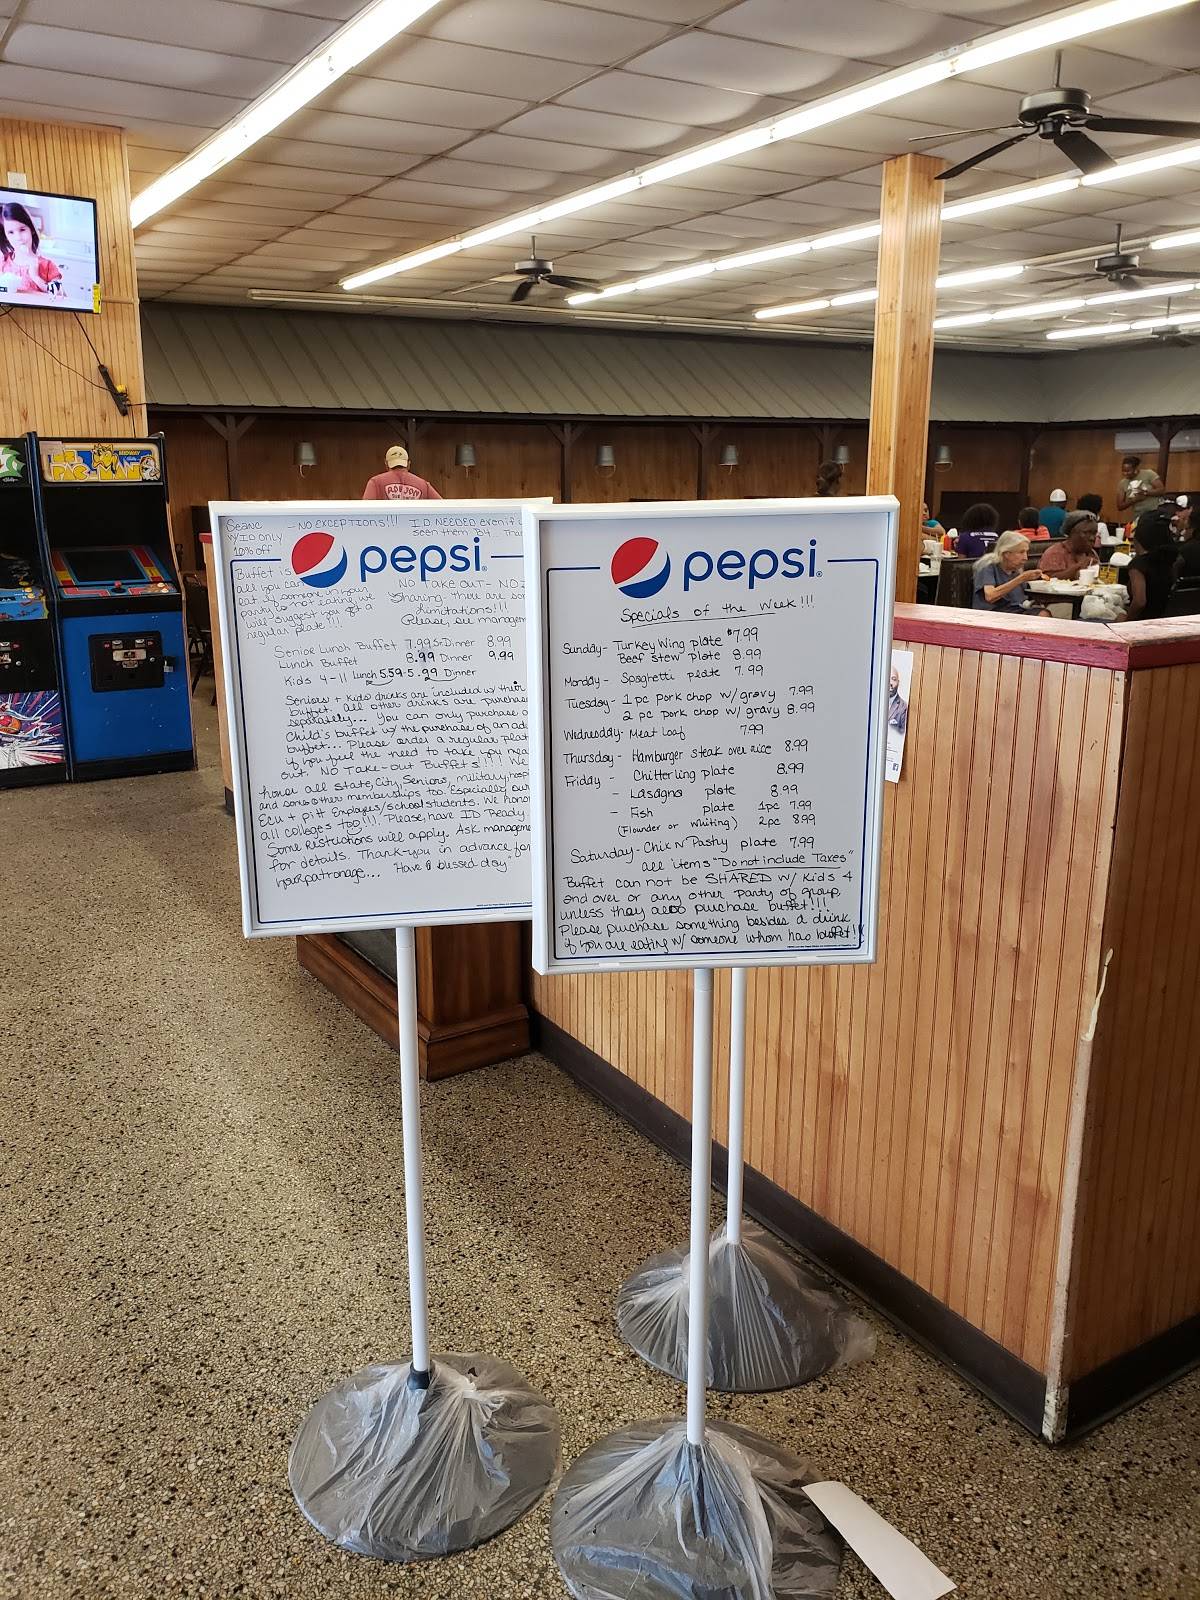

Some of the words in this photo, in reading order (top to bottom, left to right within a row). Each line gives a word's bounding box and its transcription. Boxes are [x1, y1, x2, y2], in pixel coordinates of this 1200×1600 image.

[360, 536, 480, 582] pepsi
[683, 539, 816, 592] pepsi
[235, 566, 274, 581] Buffet
[620, 606, 680, 624] Specials
[694, 604, 710, 617] of
[722, 603, 747, 614] the
[319, 643, 351, 654] Lunch
[354, 638, 398, 651] Buffet
[404, 638, 432, 649] 7.99
[487, 635, 512, 647] 8.99
[612, 640, 655, 655] Turkey
[657, 638, 686, 655] Wing
[690, 636, 723, 651] plate
[279, 659, 314, 669] Lunch
[319, 656, 359, 668] Buffet
[440, 653, 473, 663] Dinner
[488, 650, 515, 661] 9.99
[617, 652, 645, 664] Beef
[651, 654, 681, 662] stew
[688, 651, 721, 663] plate
[732, 648, 762, 660] 8.99
[284, 675, 312, 687] Kids
[352, 670, 378, 680] Lunch
[443, 668, 477, 677] Dinner
[620, 670, 675, 688] Spaghetti
[686, 668, 721, 682] plate
[734, 664, 764, 676] 7.99
[686, 692, 713, 703] chop
[788, 685, 814, 696] 7.99
[693, 708, 719, 718] chop
[745, 705, 780, 719] gravy
[786, 701, 816, 714] 8.99
[286, 729, 331, 742] Child's
[335, 727, 378, 738] buffet
[400, 724, 421, 733] the
[421, 723, 475, 734] purchase
[476, 723, 492, 735] of
[629, 728, 658, 739] Meat
[739, 724, 764, 735] 7.99
[632, 748, 684, 766] Hamburger
[690, 745, 723, 759] steak
[728, 746, 747, 756] over
[749, 744, 772, 755] rice
[784, 739, 809, 752] 8.99
[701, 764, 735, 780] plate
[776, 762, 804, 775] 8.99
[630, 788, 683, 804] Lasagna
[704, 783, 736, 800] plate
[770, 783, 799, 798] 8.99
[630, 806, 654, 819] Fish
[702, 801, 736, 815] plate
[789, 800, 812, 811] 7.99
[617, 822, 662, 838] (Flounder
[667, 822, 679, 830] or
[792, 813, 816, 826] 8.99
[267, 841, 302, 858] Some
[378, 830, 405, 843] will
[455, 823, 481, 836] Ask
[740, 837, 778, 851] plate
[789, 836, 815, 849] 7.99
[269, 858, 297, 872] for
[439, 845, 452, 854] in
[459, 842, 512, 853] advance
[740, 854, 760, 866] not
[762, 853, 806, 864] include
[563, 876, 605, 888] Buffet
[615, 878, 641, 889] can
[645, 877, 672, 887] not
[681, 874, 698, 886] be
[704, 872, 773, 885] SHARED
[802, 872, 836, 882] Kids
[842, 871, 853, 883] 4
[562, 892, 588, 905] and
[592, 894, 620, 904] over
[627, 894, 641, 903] or
[650, 893, 682, 908] any
[688, 889, 726, 900] other
[779, 886, 797, 901] of
[560, 907, 605, 921] unless
[558, 923, 603, 937] Please
[745, 915, 789, 928] besides
[812, 912, 851, 925] drink
[564, 937, 578, 956] if
[580, 938, 603, 953] you
[604, 938, 628, 952] are
[630, 936, 670, 954] eating
[745, 931, 783, 944] whom
[788, 929, 812, 942] has
